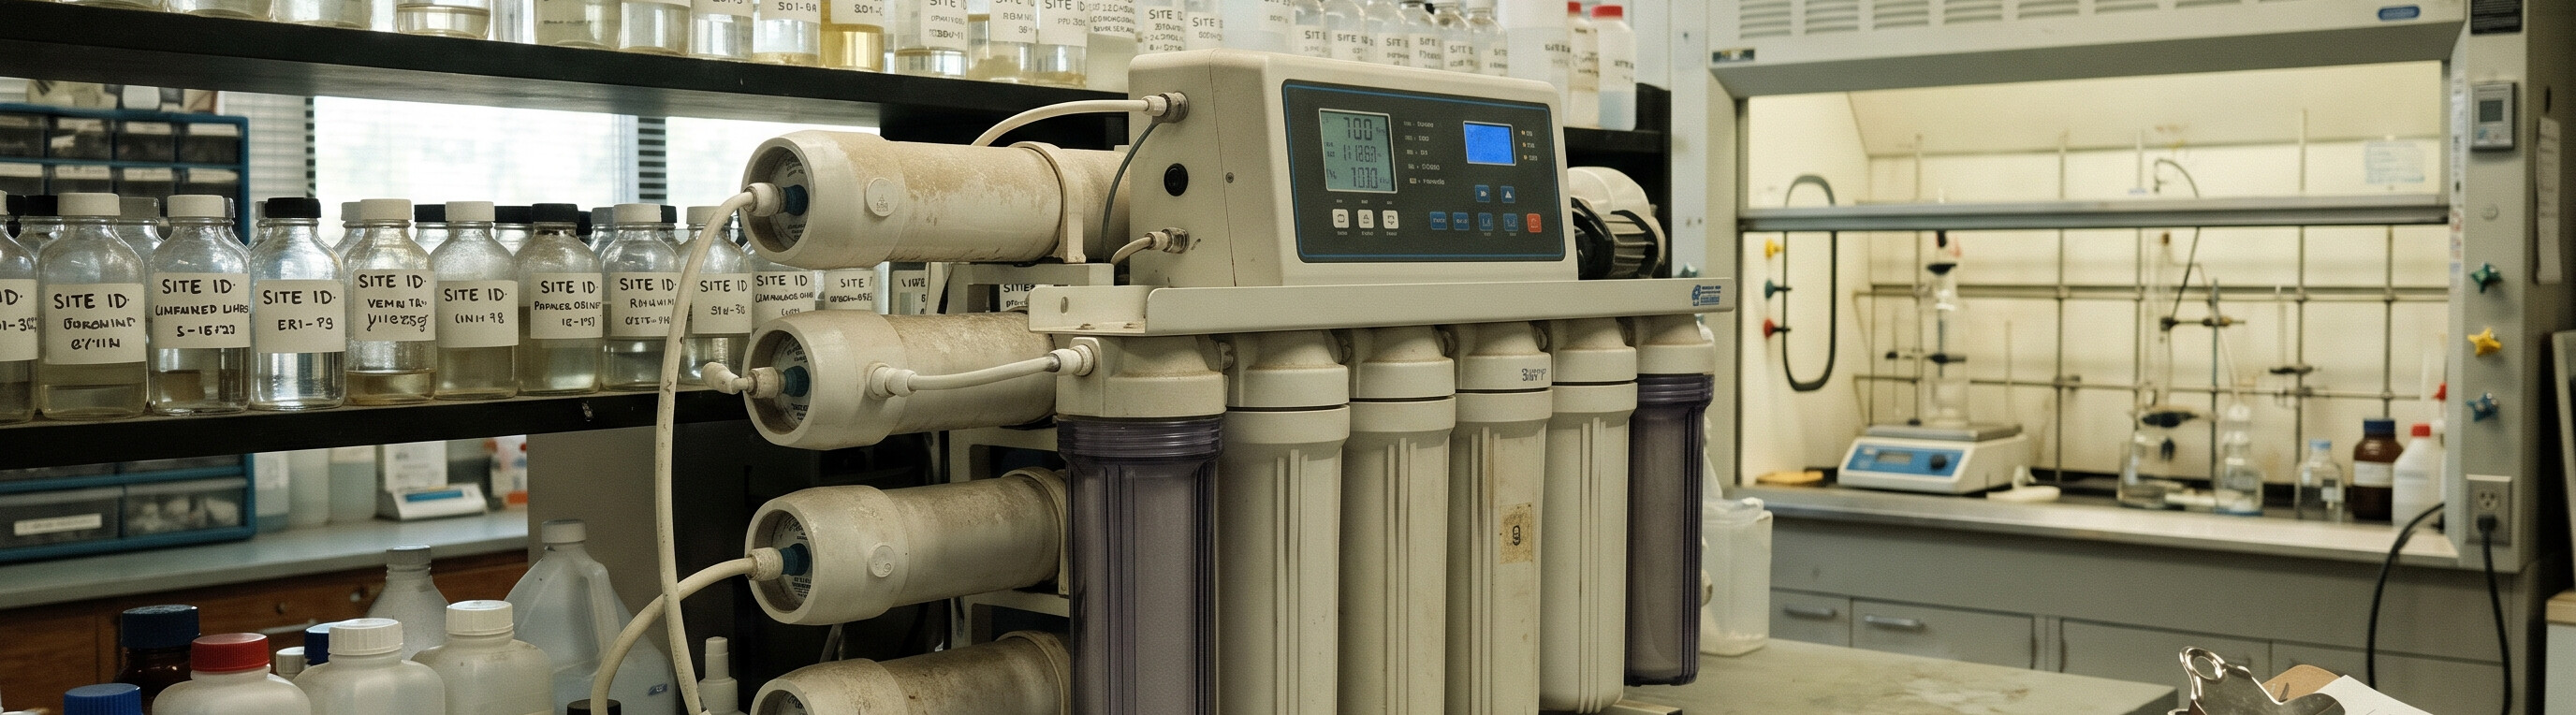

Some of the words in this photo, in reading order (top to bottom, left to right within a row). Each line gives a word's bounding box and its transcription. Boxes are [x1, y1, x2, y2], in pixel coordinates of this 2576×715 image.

[1046, 0, 1072, 10] SITE
[1149, 8, 1173, 20] SITE
[1192, 17, 1215, 27] SITE
[1337, 33, 1356, 43] SITE
[1343, 116, 1373, 140] 700
[162, 279, 202, 294] SITE
[358, 273, 397, 289] SITE
[540, 280, 575, 294] SITE
[619, 277, 654, 291] SITE
[700, 279, 731, 292] SITE
[737, 280, 748, 292] ID
[756, 274, 786, 286] SITE
[795, 274, 808, 286] ID
[840, 278, 865, 288] SITE
[53, 293, 95, 309] SITE
[263, 289, 302, 305] SITE
[444, 288, 479, 302] SITE
